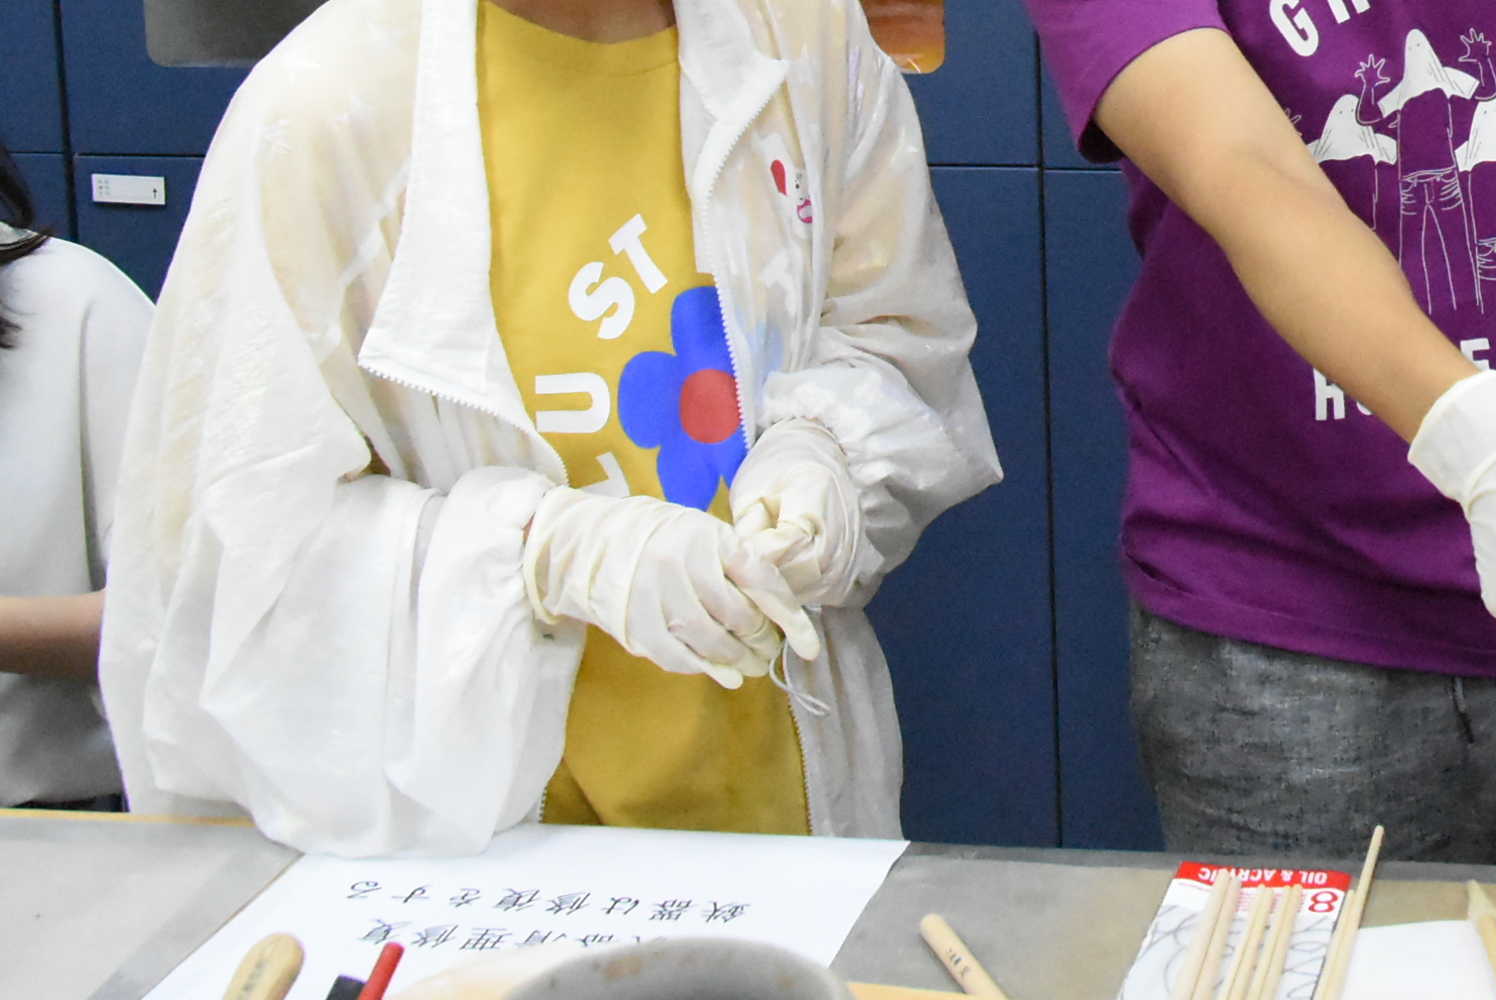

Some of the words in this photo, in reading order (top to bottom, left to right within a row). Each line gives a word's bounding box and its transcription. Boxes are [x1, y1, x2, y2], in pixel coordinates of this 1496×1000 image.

[1280, 869, 1294, 882] &
[1299, 870, 1328, 885] OIL
[1308, 891, 1338, 913] 8
